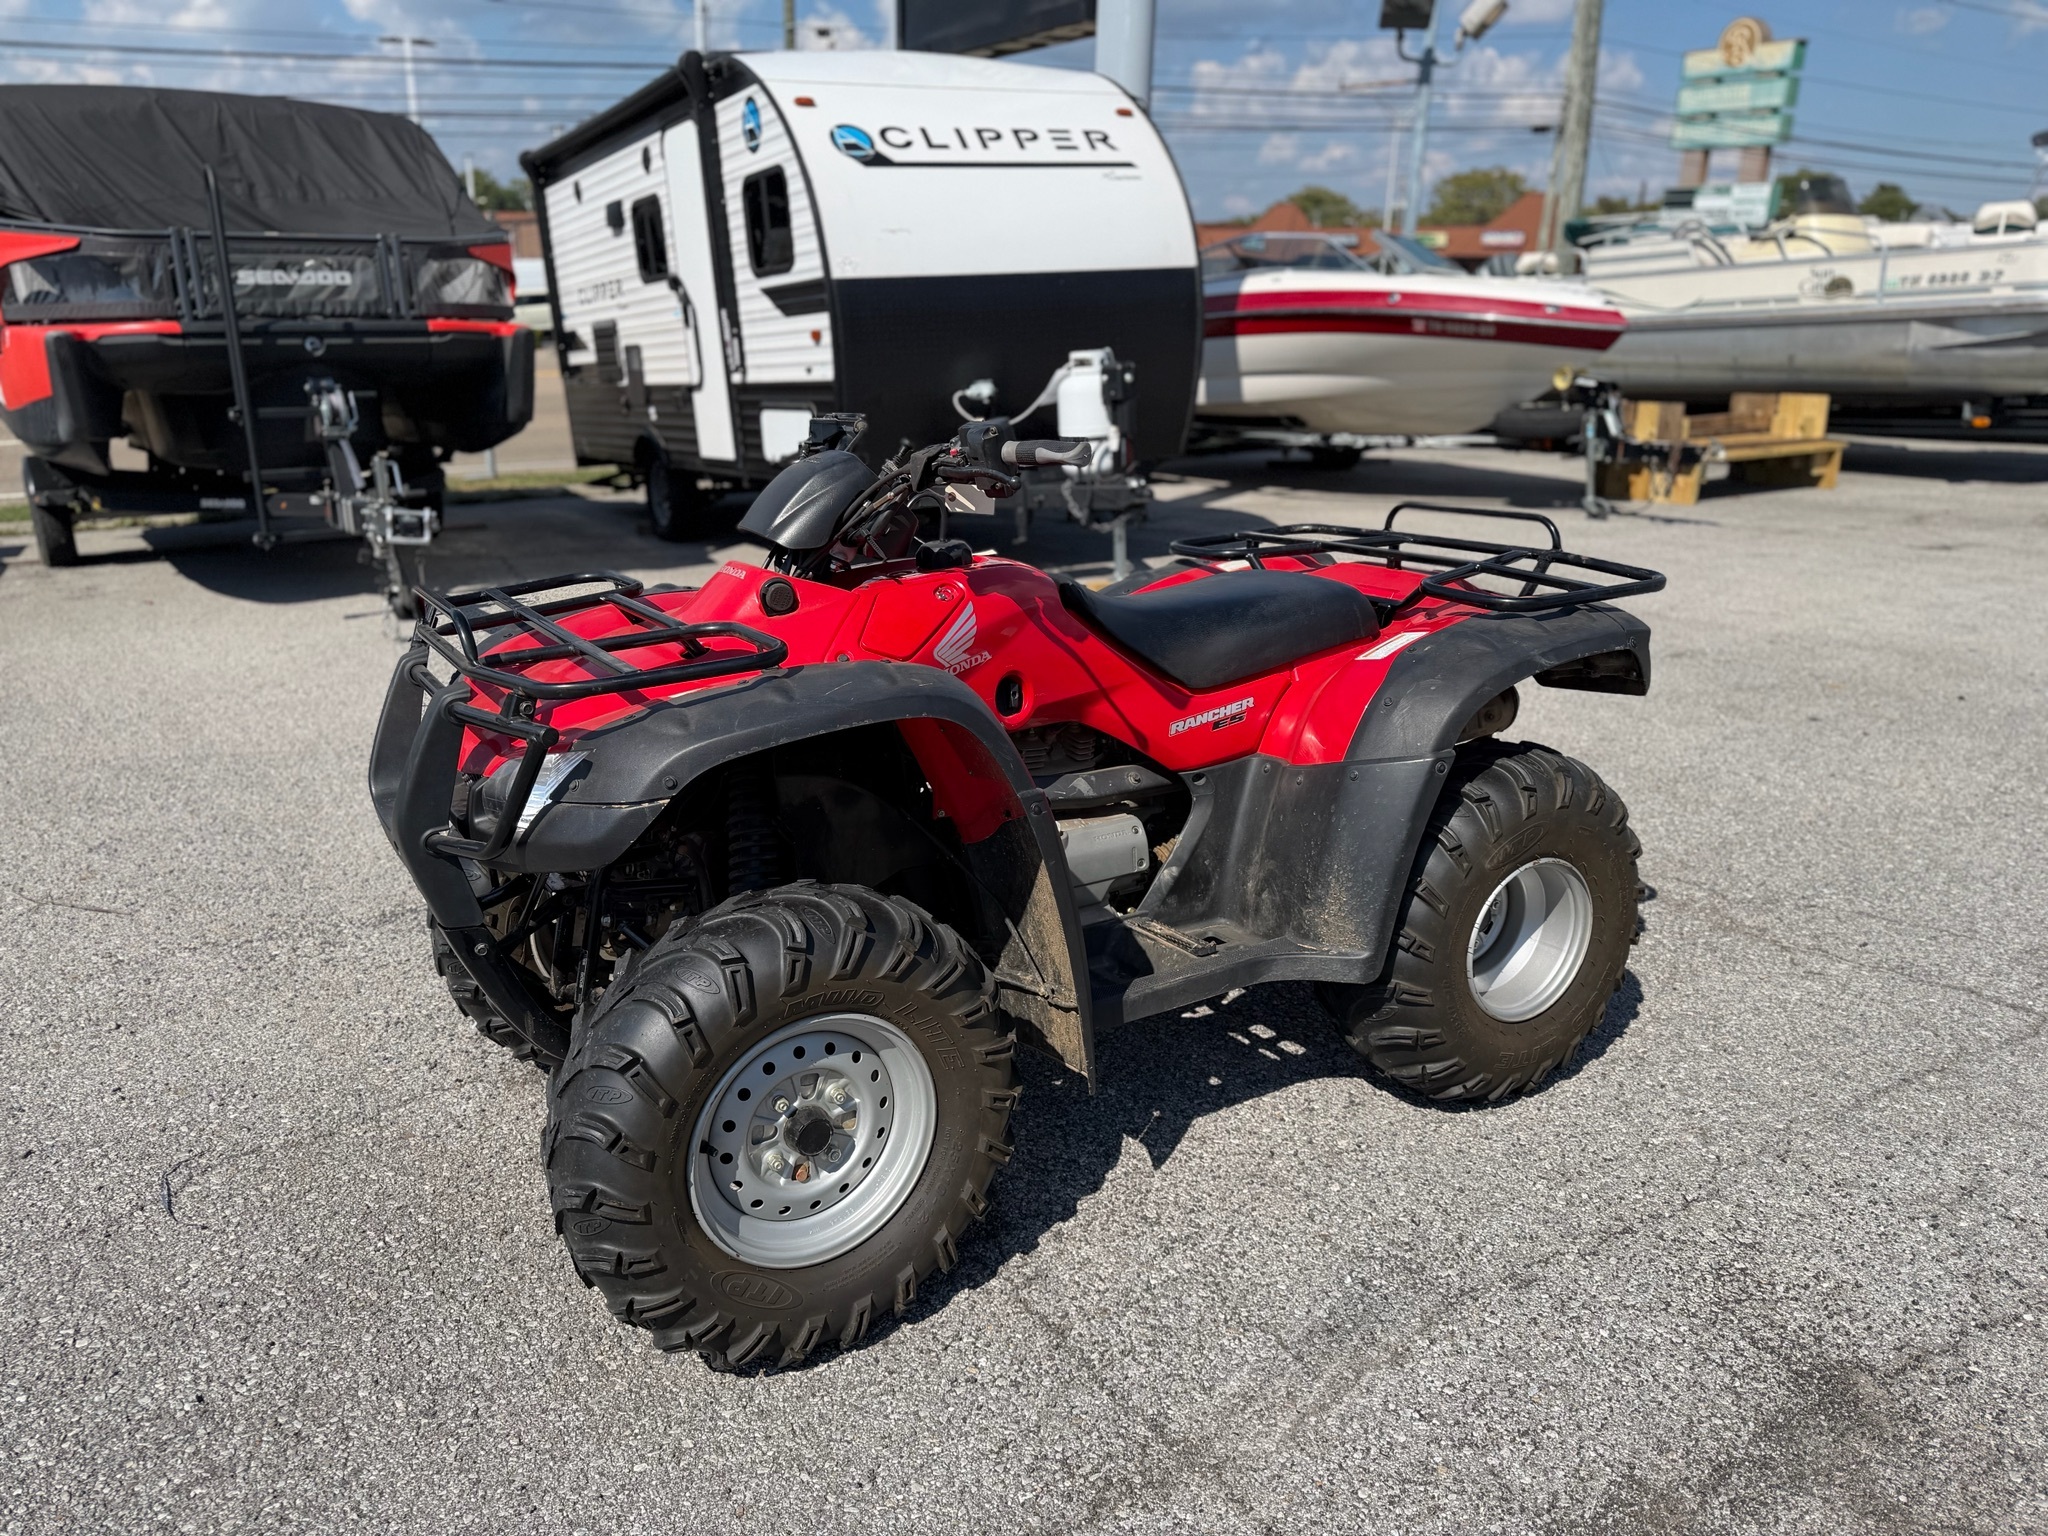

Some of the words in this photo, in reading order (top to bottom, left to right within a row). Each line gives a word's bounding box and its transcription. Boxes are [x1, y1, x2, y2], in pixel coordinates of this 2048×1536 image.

[878, 126, 1119, 151] CLIPPER
[1168, 697, 1255, 737] RANCHER
[1211, 711, 1248, 731] ES
[680, 969, 712, 988] ITP
[782, 989, 885, 1019] MUD
[893, 1001, 966, 1070] LITE
[591, 1089, 622, 1102] ITP
[902, 1199, 926, 1227] SERVICE
[579, 1221, 602, 1234] ITP
[726, 1277, 785, 1305] ITP
